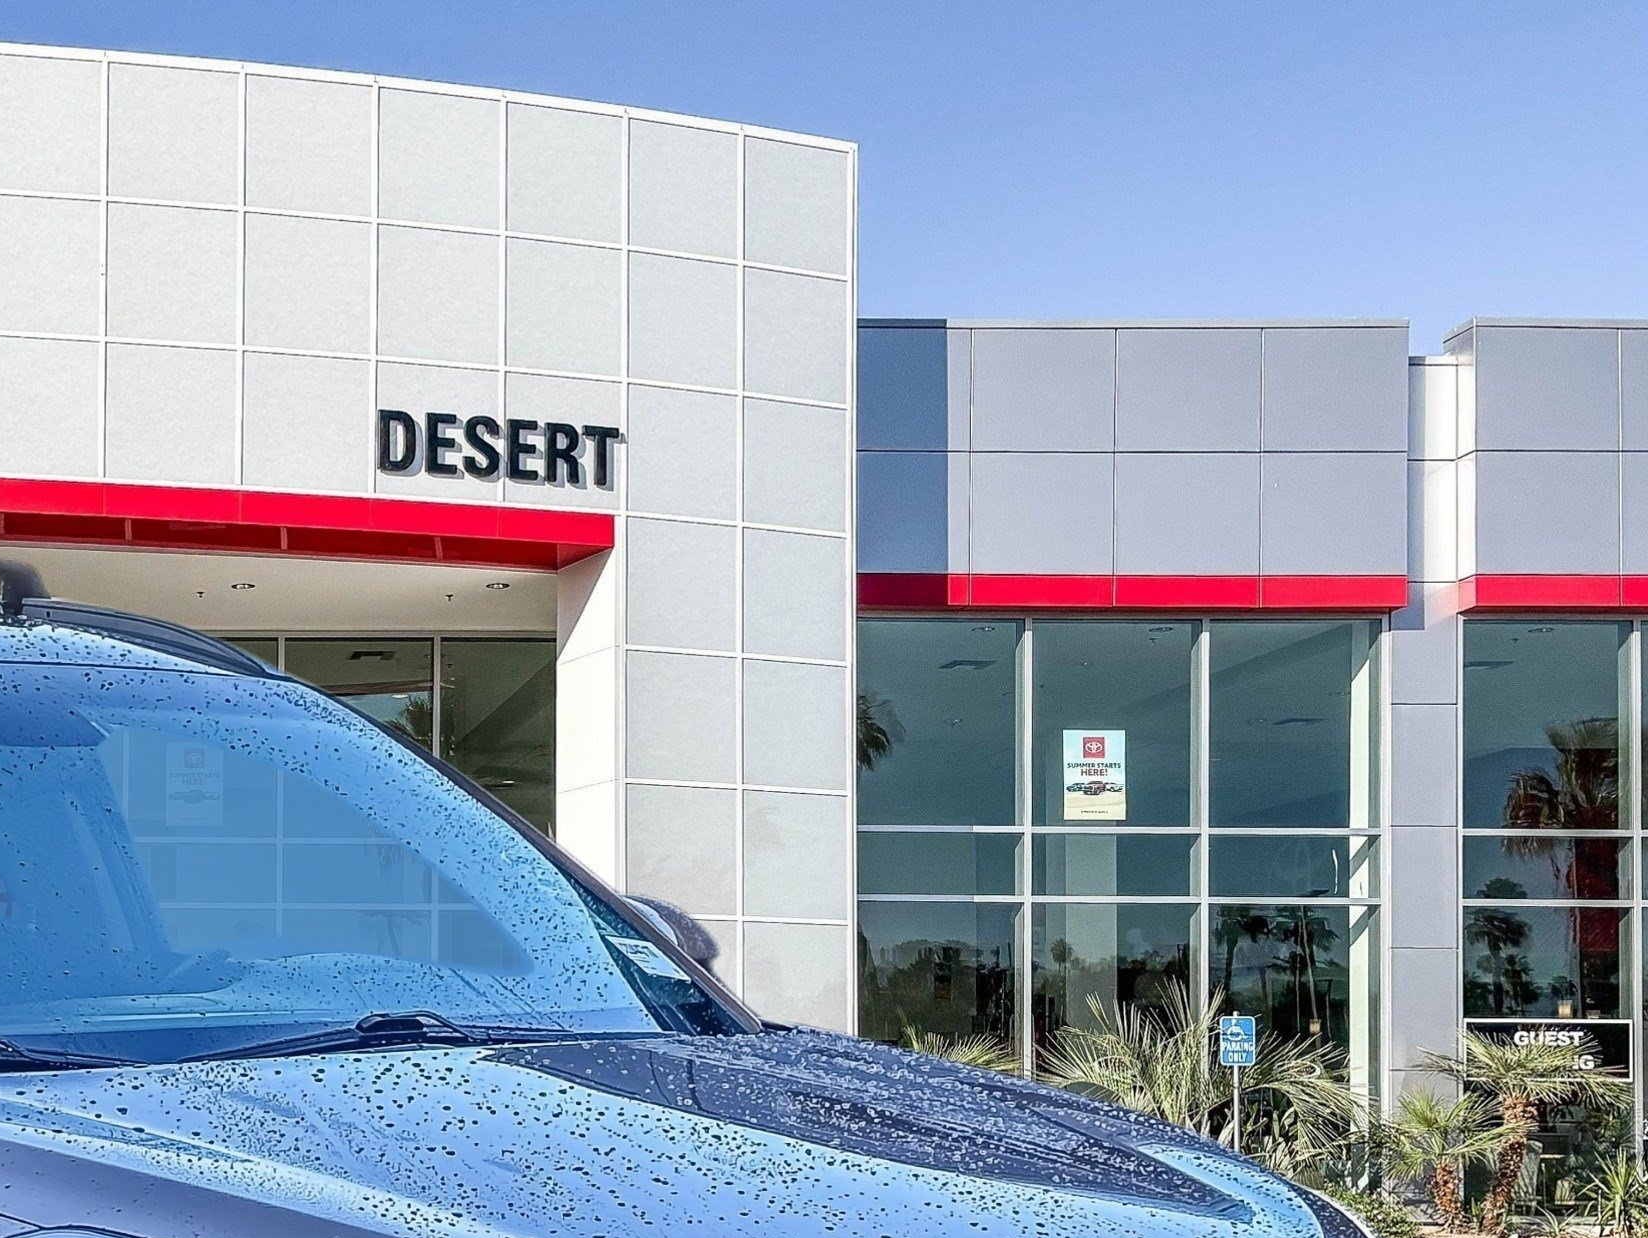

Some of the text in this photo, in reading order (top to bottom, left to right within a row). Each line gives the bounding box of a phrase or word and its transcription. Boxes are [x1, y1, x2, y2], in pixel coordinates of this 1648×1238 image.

[377, 409, 620, 486] DESERT
[1080, 768, 1108, 776] HERE!
[1514, 1030, 1583, 1047] GUEST
[1222, 1041, 1254, 1052] PARKING
[1229, 1051, 1247, 1062] ONLY
